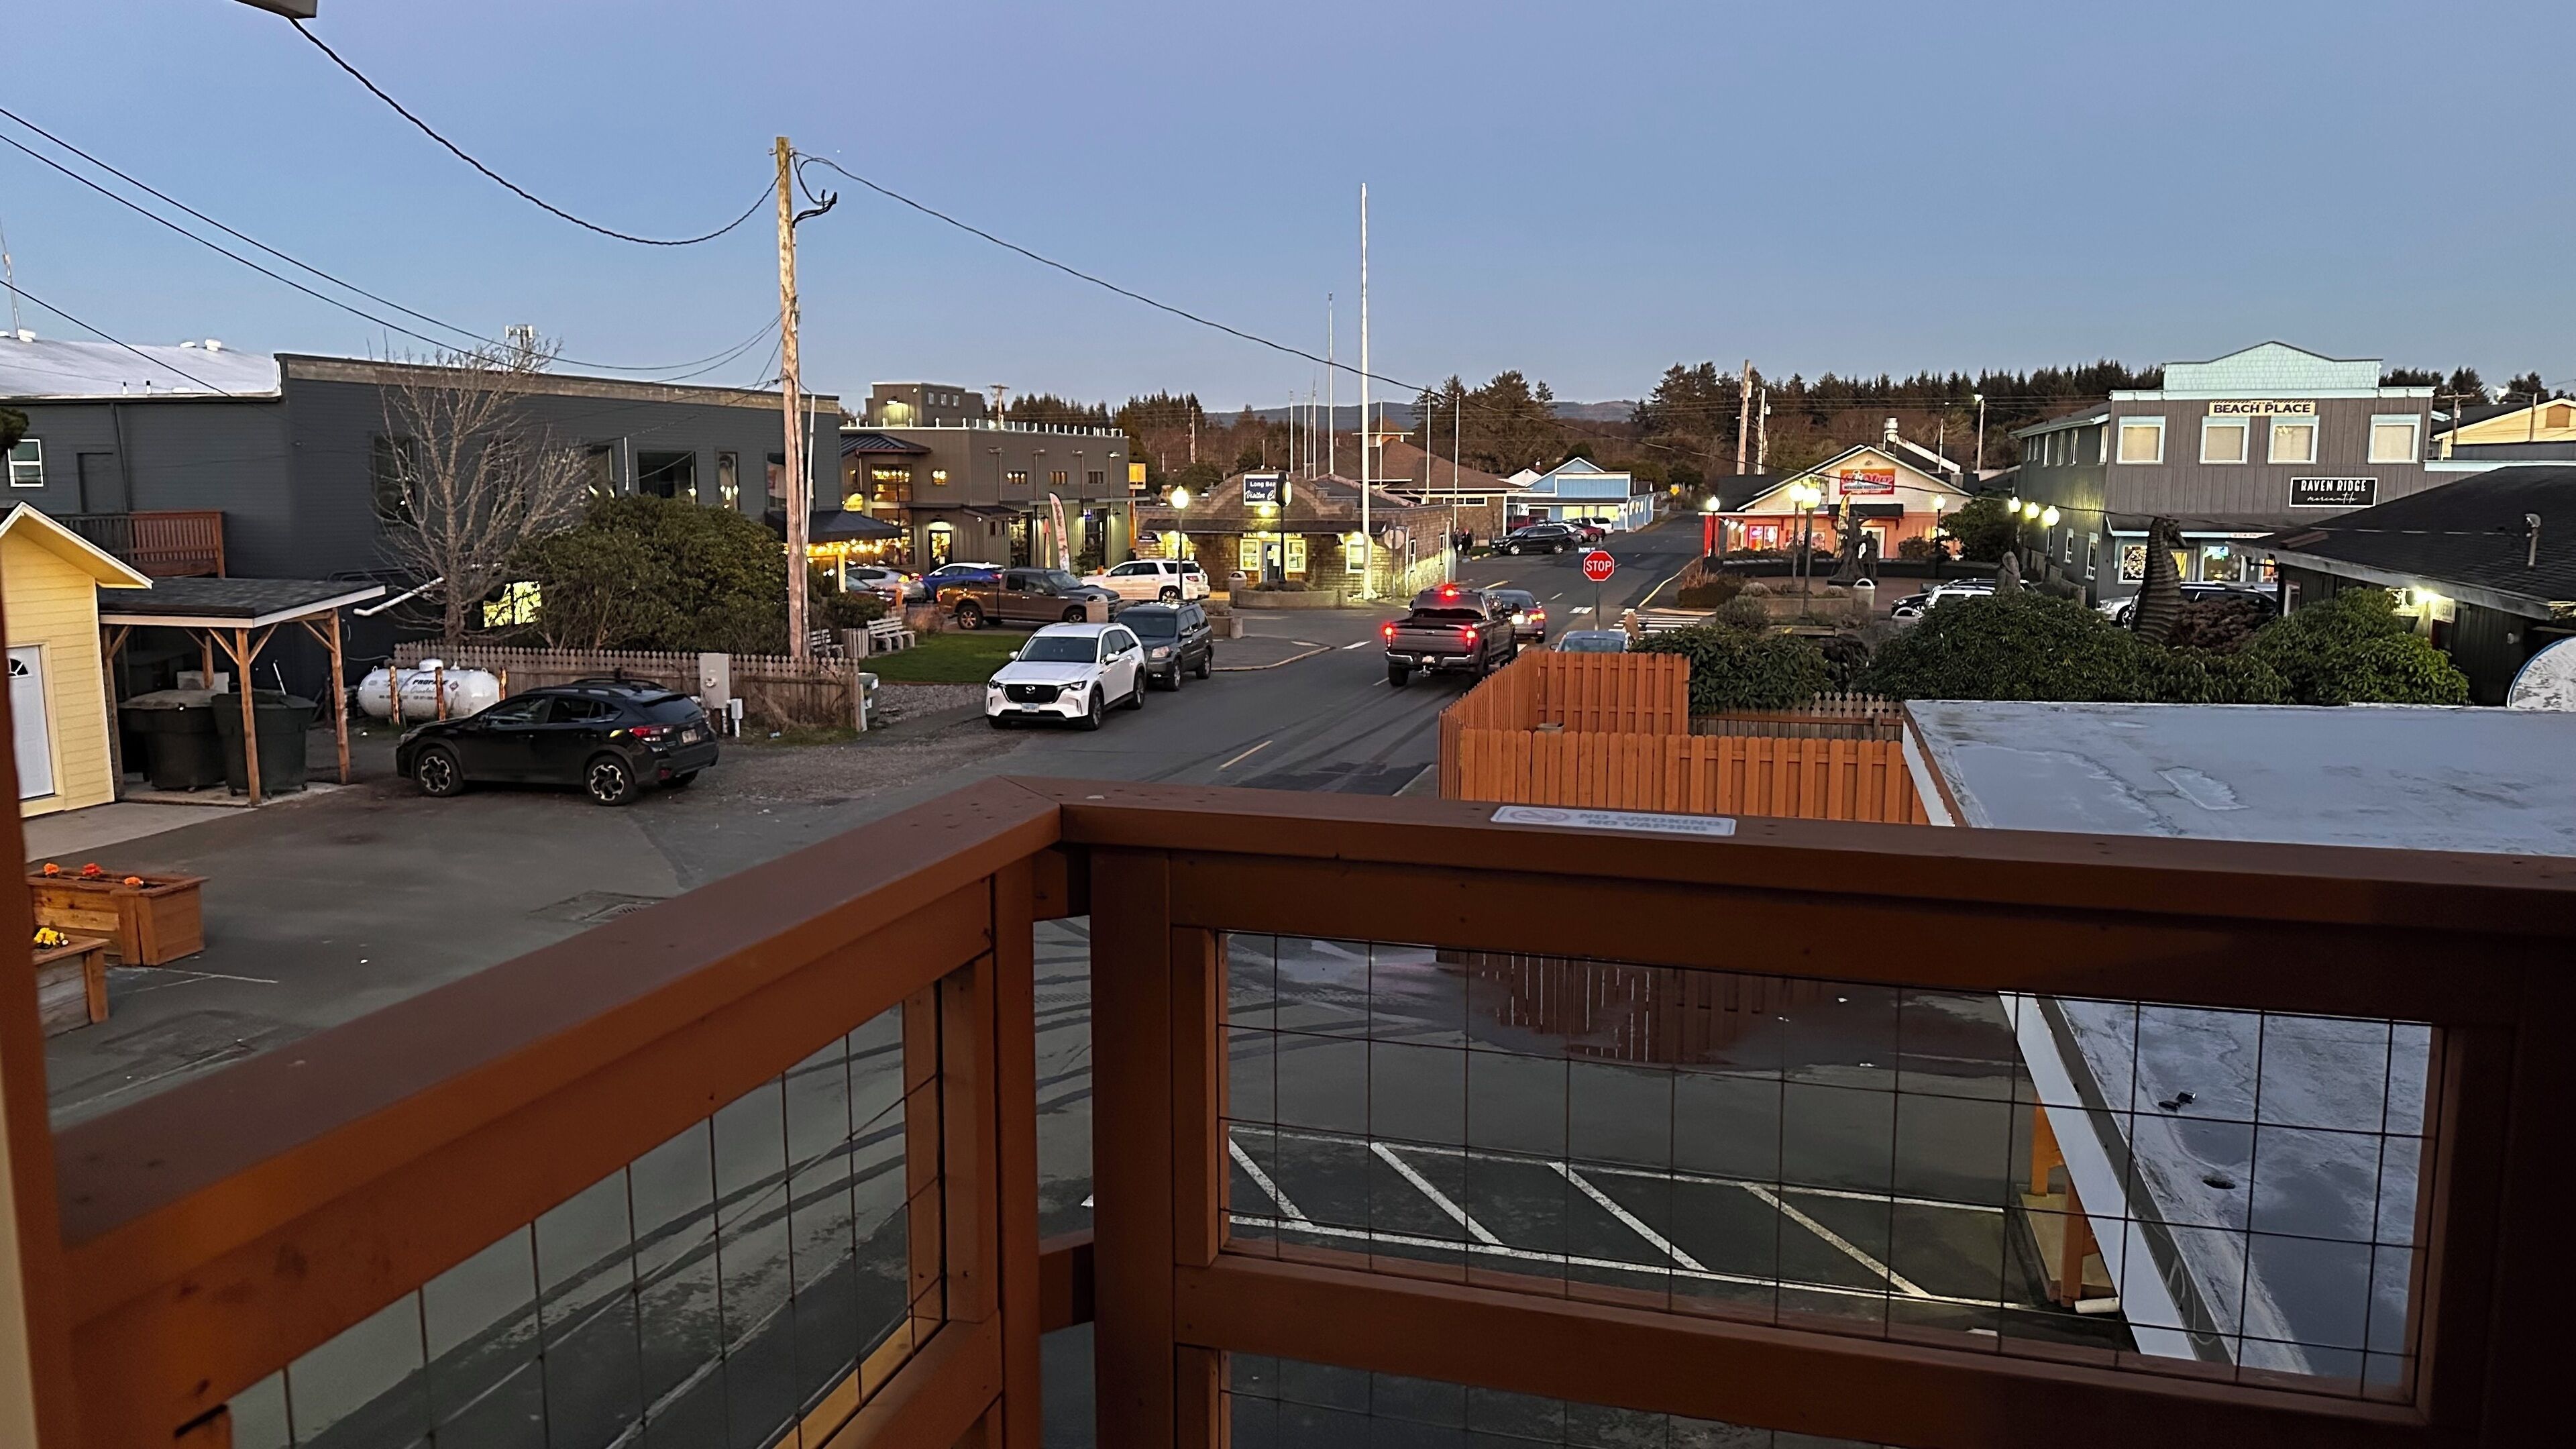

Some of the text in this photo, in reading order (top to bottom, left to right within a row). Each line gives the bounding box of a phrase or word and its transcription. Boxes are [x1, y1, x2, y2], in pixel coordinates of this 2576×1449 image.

[2214, 404, 2310, 413] BEACH PLACE
[2300, 480, 2367, 492] RAVEN RIDGE
[1246, 490, 1265, 498] Visitor
[1586, 560, 1612, 572] STOP
[1617, 816, 1721, 826] SMOKING
[1624, 822, 1707, 831] VAPING
